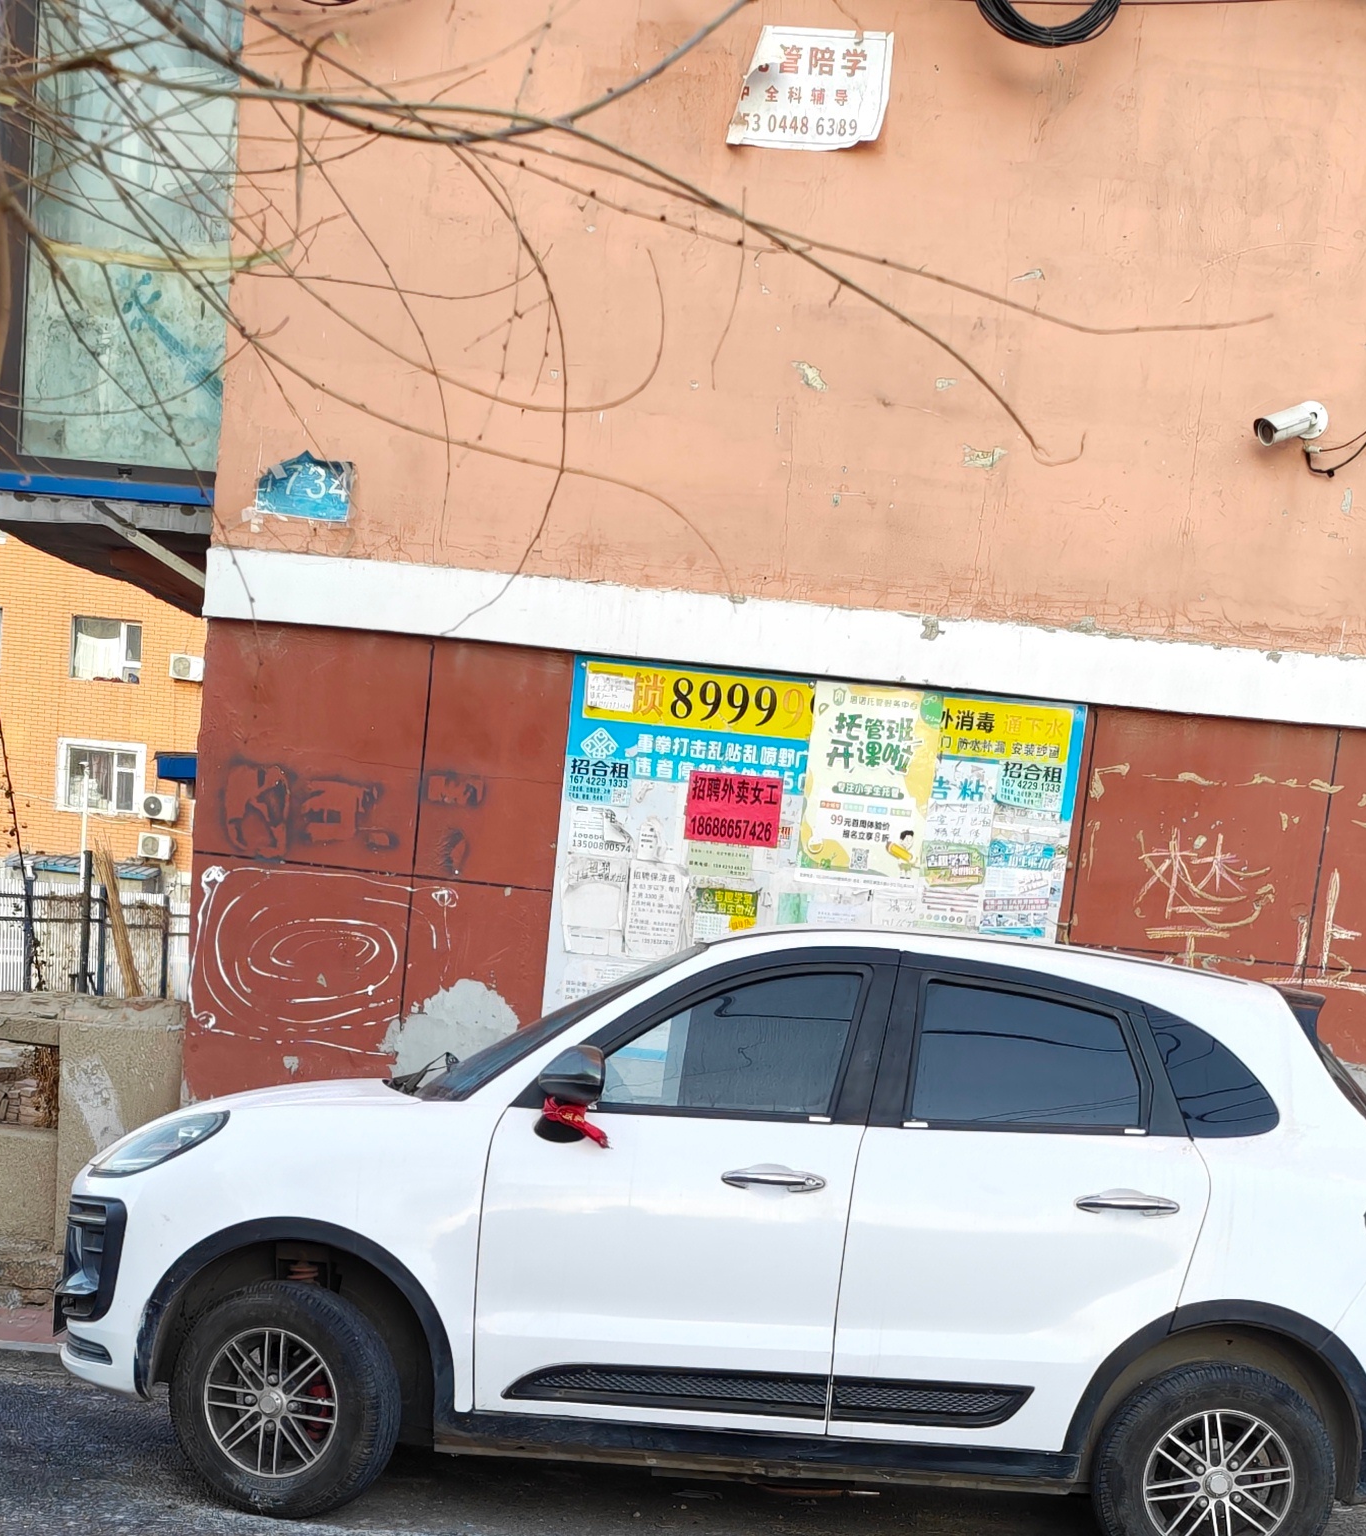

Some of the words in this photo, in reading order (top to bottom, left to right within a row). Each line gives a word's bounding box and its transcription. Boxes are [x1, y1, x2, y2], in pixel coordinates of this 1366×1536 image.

[758, 44, 868, 77] 管陪学
[767, 114, 810, 136] 0448
[815, 118, 858, 137] 6389
[834, 712, 915, 743] 托管班
[1003, 713, 1065, 739] 通下水
[825, 738, 914, 773] 开课啦
[957, 736, 1006, 755] 防水补漏
[570, 757, 629, 780] 招合租
[1001, 761, 1063, 784] 招合租
[569, 775, 585, 785] 167
[585, 777, 608, 787] 4229
[608, 779, 629, 789] 1333
[691, 776, 779, 806] 招聘外卖女工
[837, 781, 902, 799] 专注小学生托管
[1000, 777, 1016, 788] 167
[1017, 780, 1039, 791] 4229
[1040, 782, 1062, 794] 1333
[690, 815, 773, 843] 18686657426
[830, 814, 891, 832] 99元首周体验价
[572, 839, 631, 853] 13500800574
